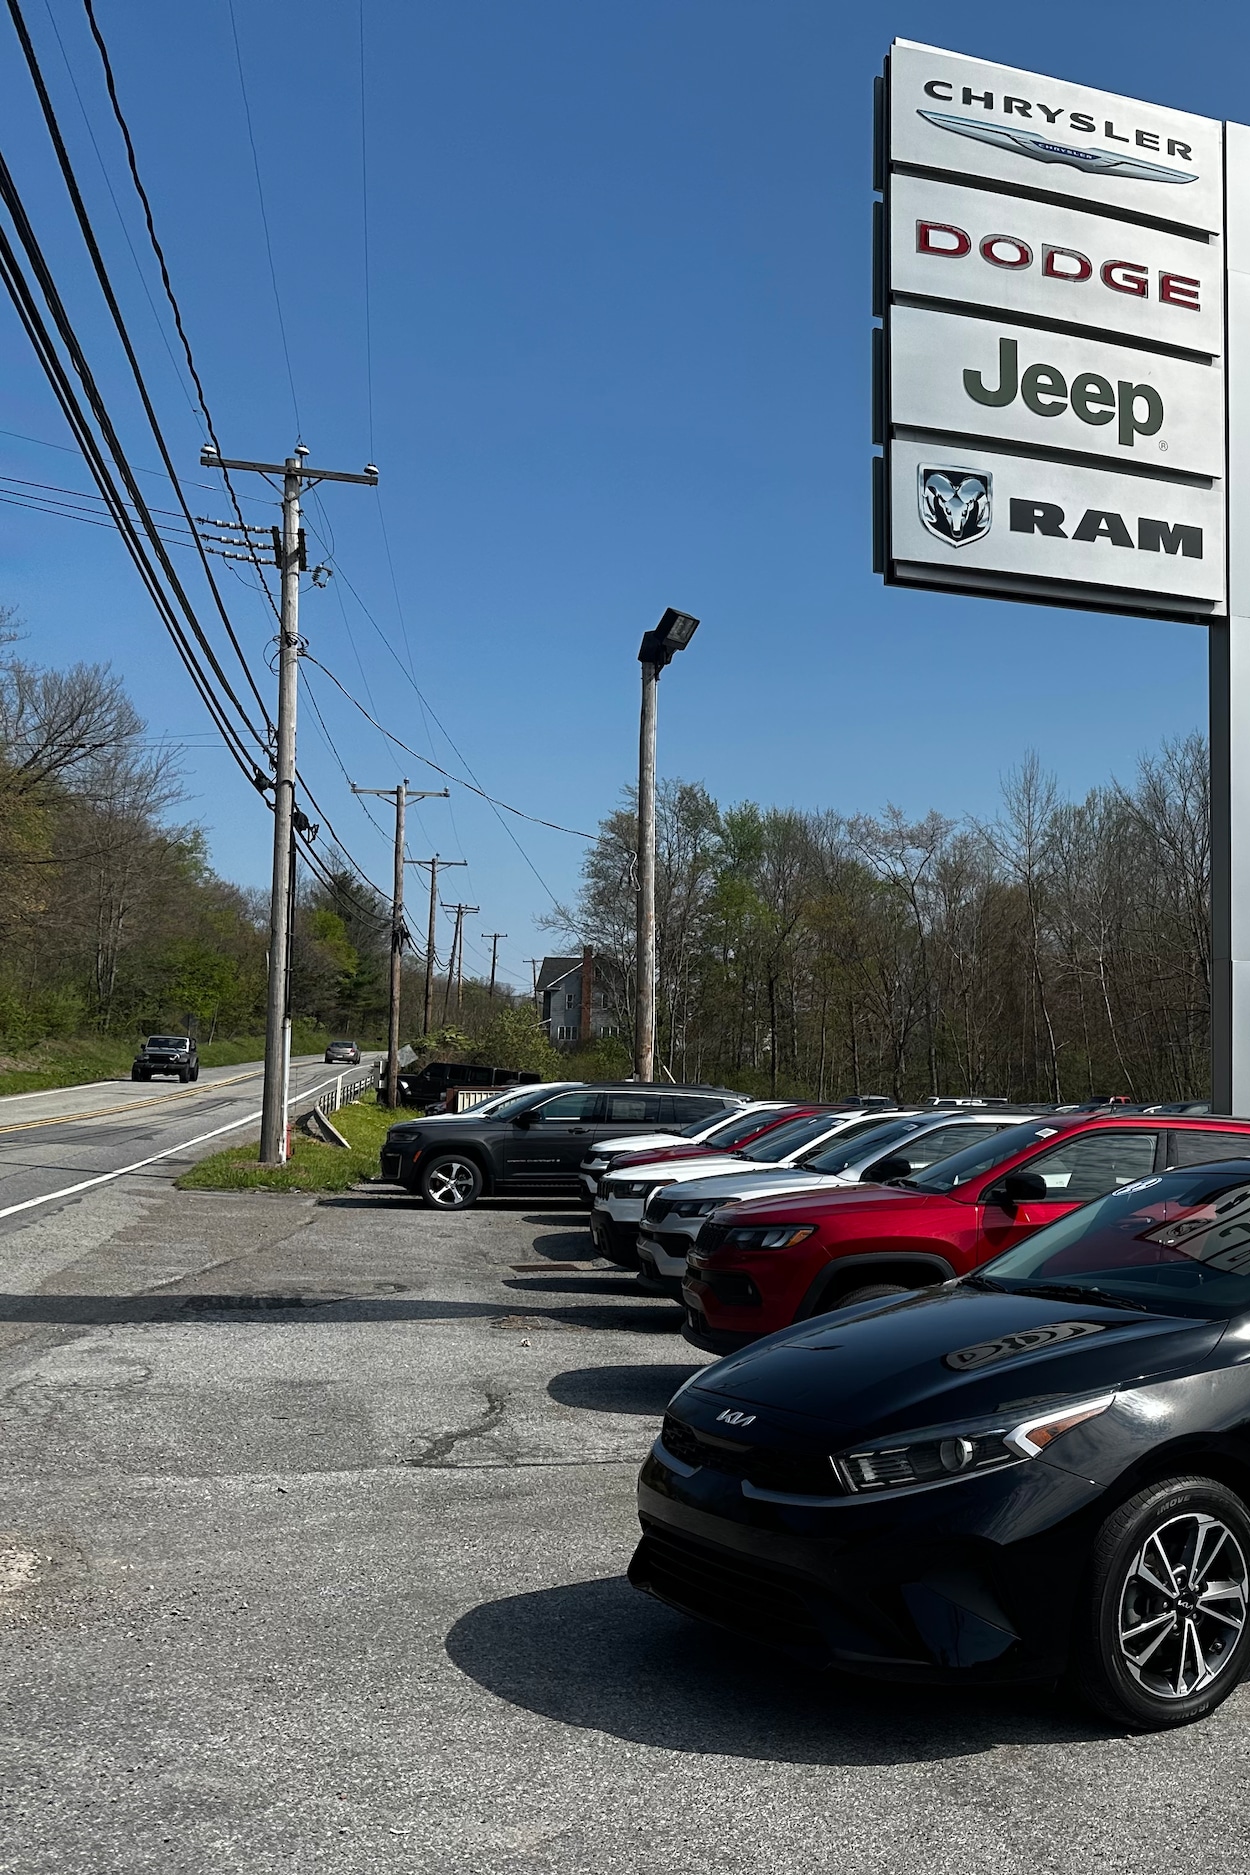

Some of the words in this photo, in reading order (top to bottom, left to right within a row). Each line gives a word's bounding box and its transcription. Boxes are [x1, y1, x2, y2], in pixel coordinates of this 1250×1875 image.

[923, 80, 1194, 161] CHRYSLER
[1038, 143, 1093, 160] CHRYSLER
[915, 219, 1201, 312] DODGE
[962, 337, 1164, 447] Jeep
[1009, 497, 1204, 560] RAM
